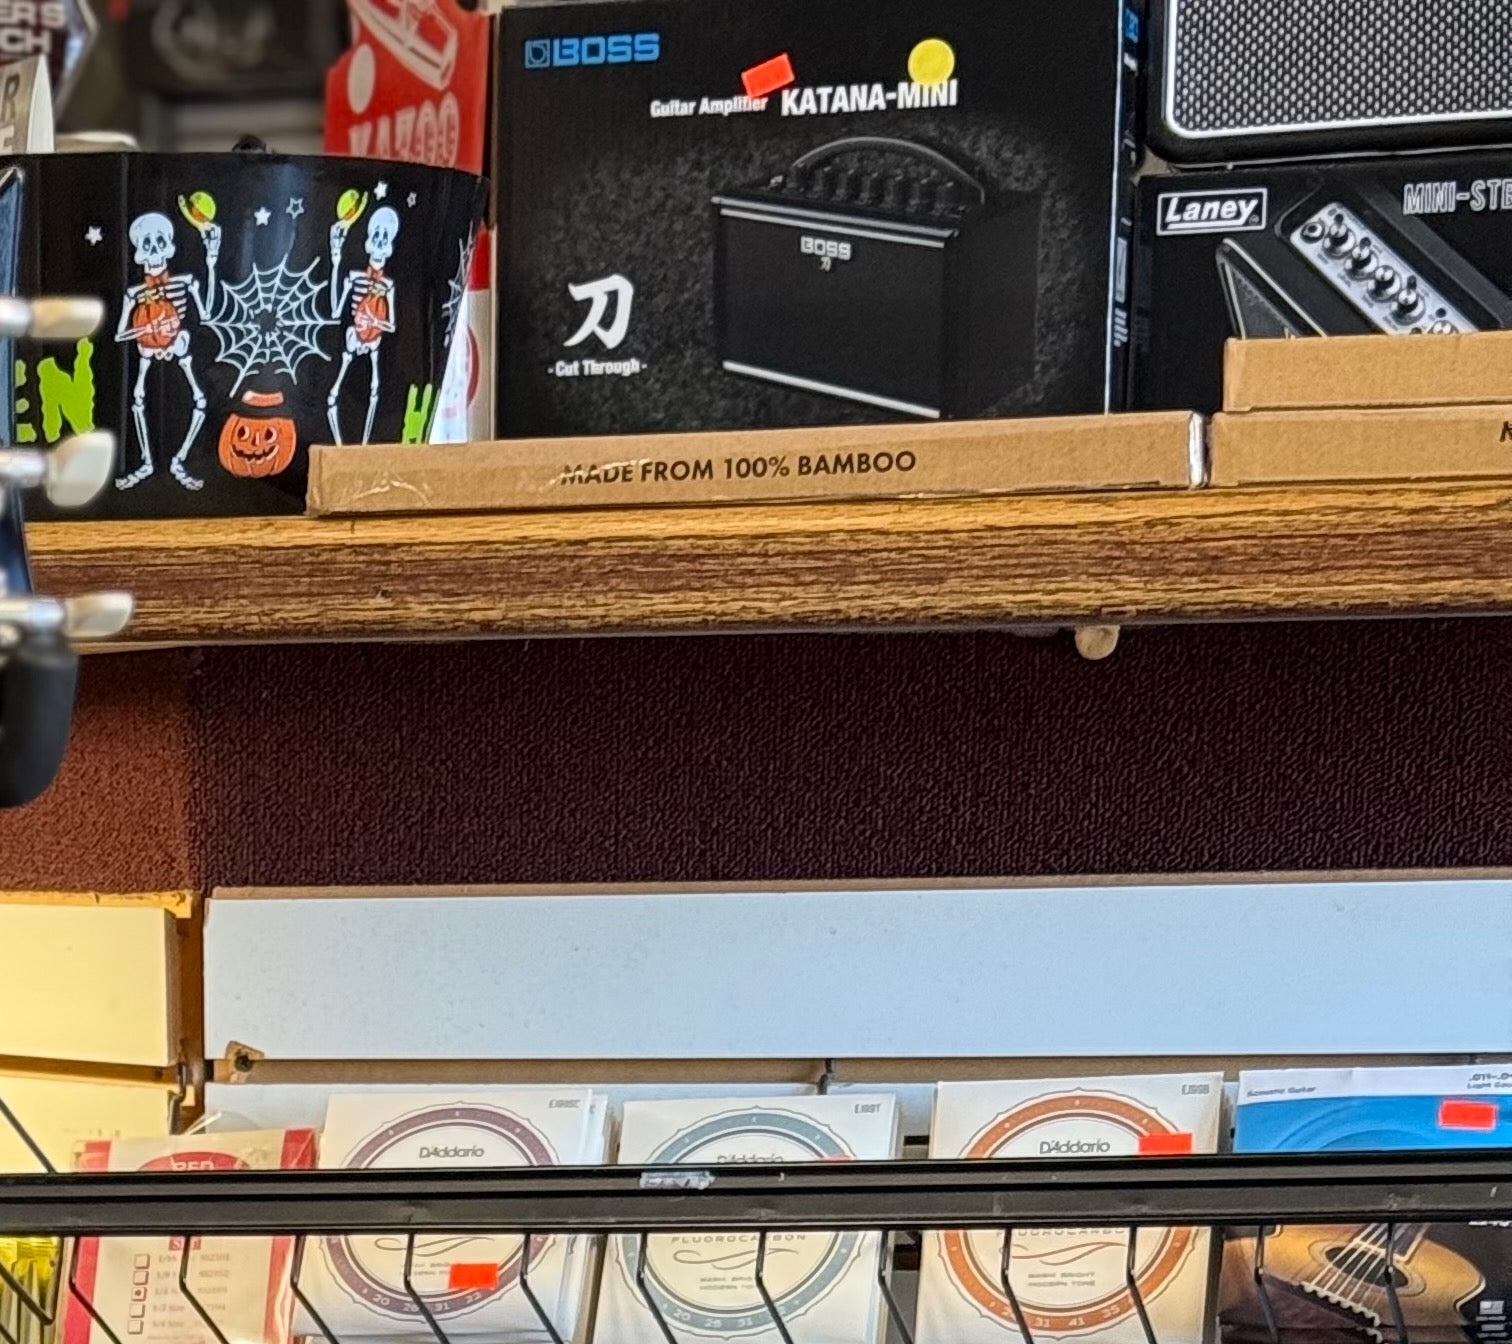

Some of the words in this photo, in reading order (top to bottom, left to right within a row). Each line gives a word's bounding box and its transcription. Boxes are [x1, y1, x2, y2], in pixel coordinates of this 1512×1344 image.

[552, 32, 661, 67] BOSS
[650, 99, 696, 118] Guitar
[699, 96, 769, 117] Amplifier
[781, 78, 958, 117] KATANA-MINI
[1165, 197, 1259, 226] Laney
[800, 235, 852, 261] BOSS
[563, 273, 635, 349] 刀
[560, 459, 634, 487] MADE
[640, 458, 715, 483] FROM
[723, 455, 791, 480] 100%
[797, 449, 918, 478] BAMBOO
[418, 1144, 485, 1159] D'Addario
[1038, 1138, 1111, 1155] D'Addario
[670, 1233, 807, 1244] FLUOROCABON
[372, 1294, 390, 1306] 20
